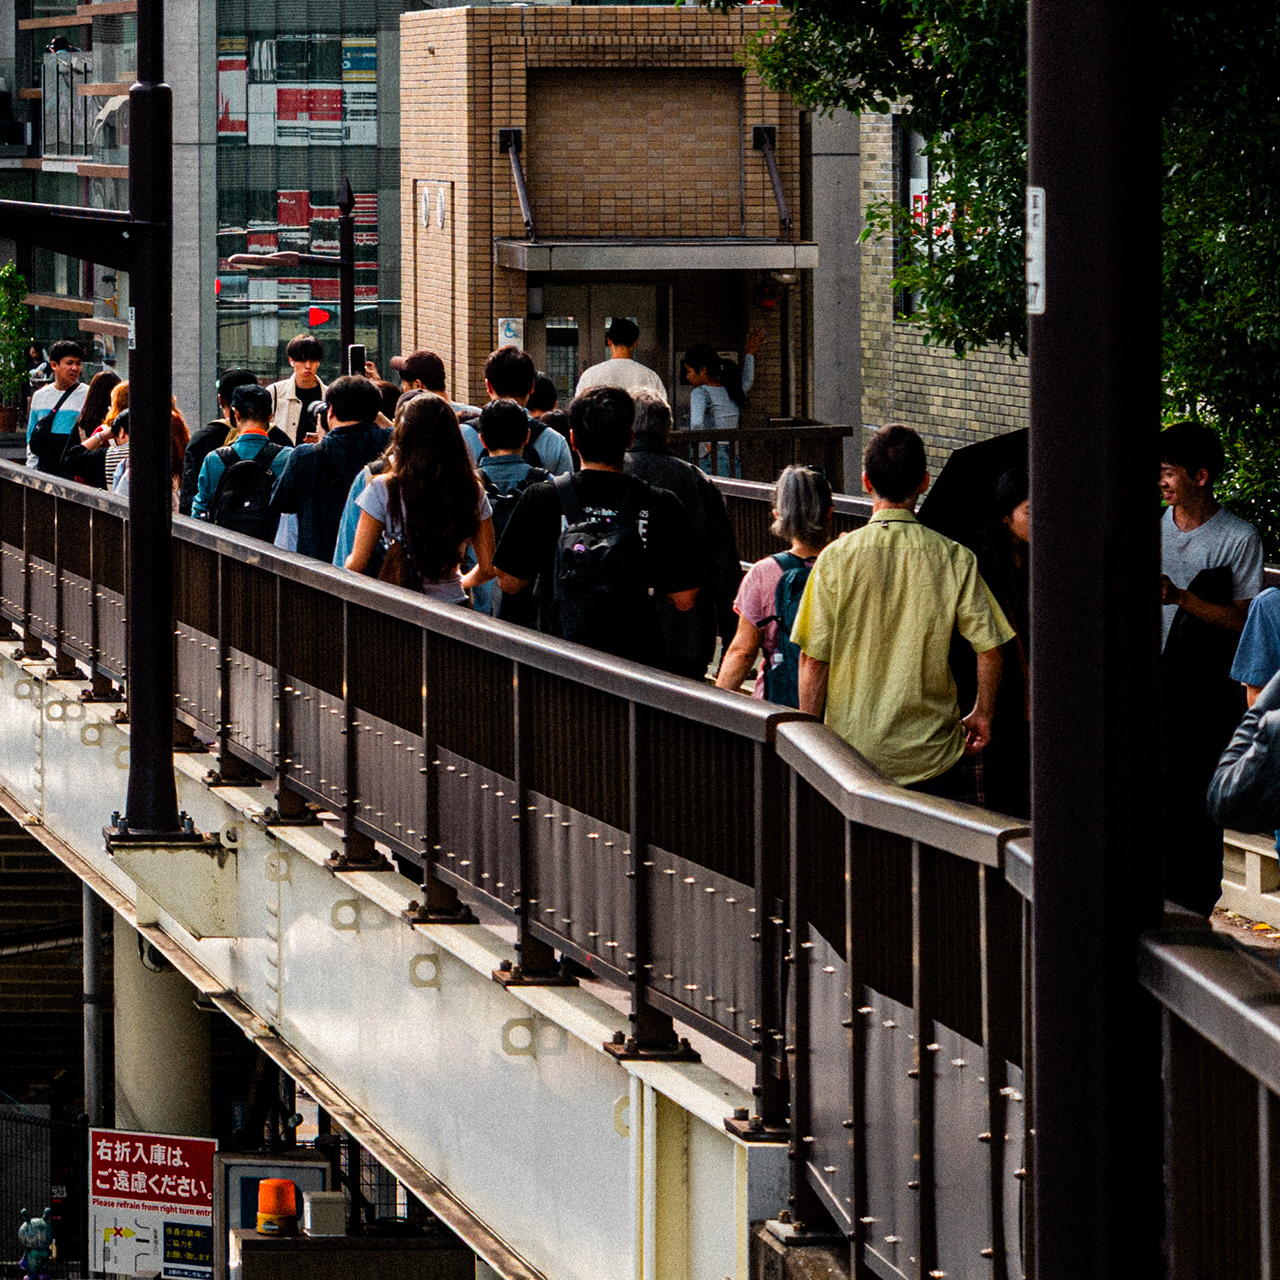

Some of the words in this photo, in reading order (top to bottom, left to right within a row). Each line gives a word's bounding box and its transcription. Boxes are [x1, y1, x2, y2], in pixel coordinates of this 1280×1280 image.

[96, 1138, 190, 1168] 右折入庫は、
[95, 1167, 213, 1201] ご遠慮ください。
[92, 1198, 115, 1209] Please
[116, 1199, 141, 1211] refrain
[142, 1202, 159, 1212] from
[160, 1203, 178, 1216] right
[179, 1206, 195, 1215] turn
[196, 1207, 213, 1217] entr
